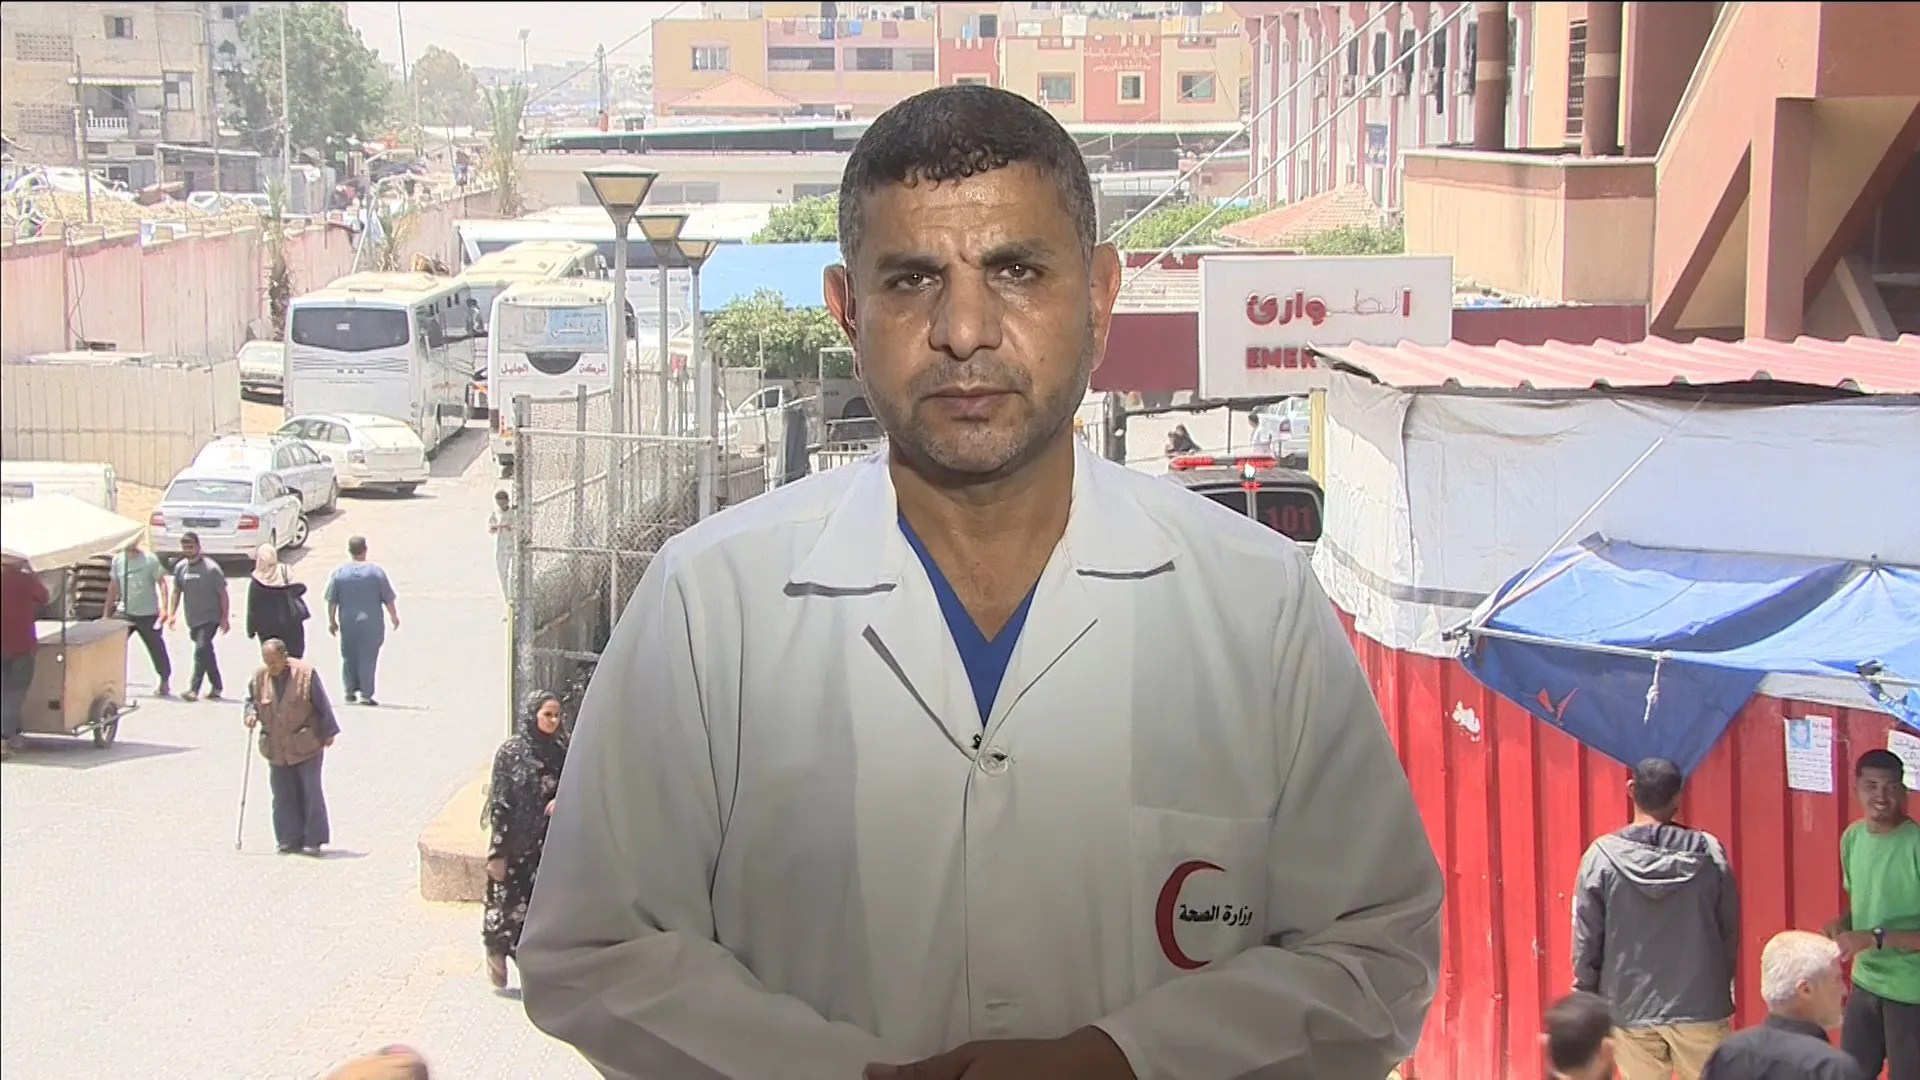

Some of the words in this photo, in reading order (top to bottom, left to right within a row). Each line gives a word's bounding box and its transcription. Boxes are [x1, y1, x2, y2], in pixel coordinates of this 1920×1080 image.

[1246, 287, 1412, 326] الطوارئ
[1246, 346, 1318, 370] EMER
[1266, 506, 1313, 533] 101
[1179, 904, 1220, 923] الصحة
[1222, 905, 1253, 926] وزارة
